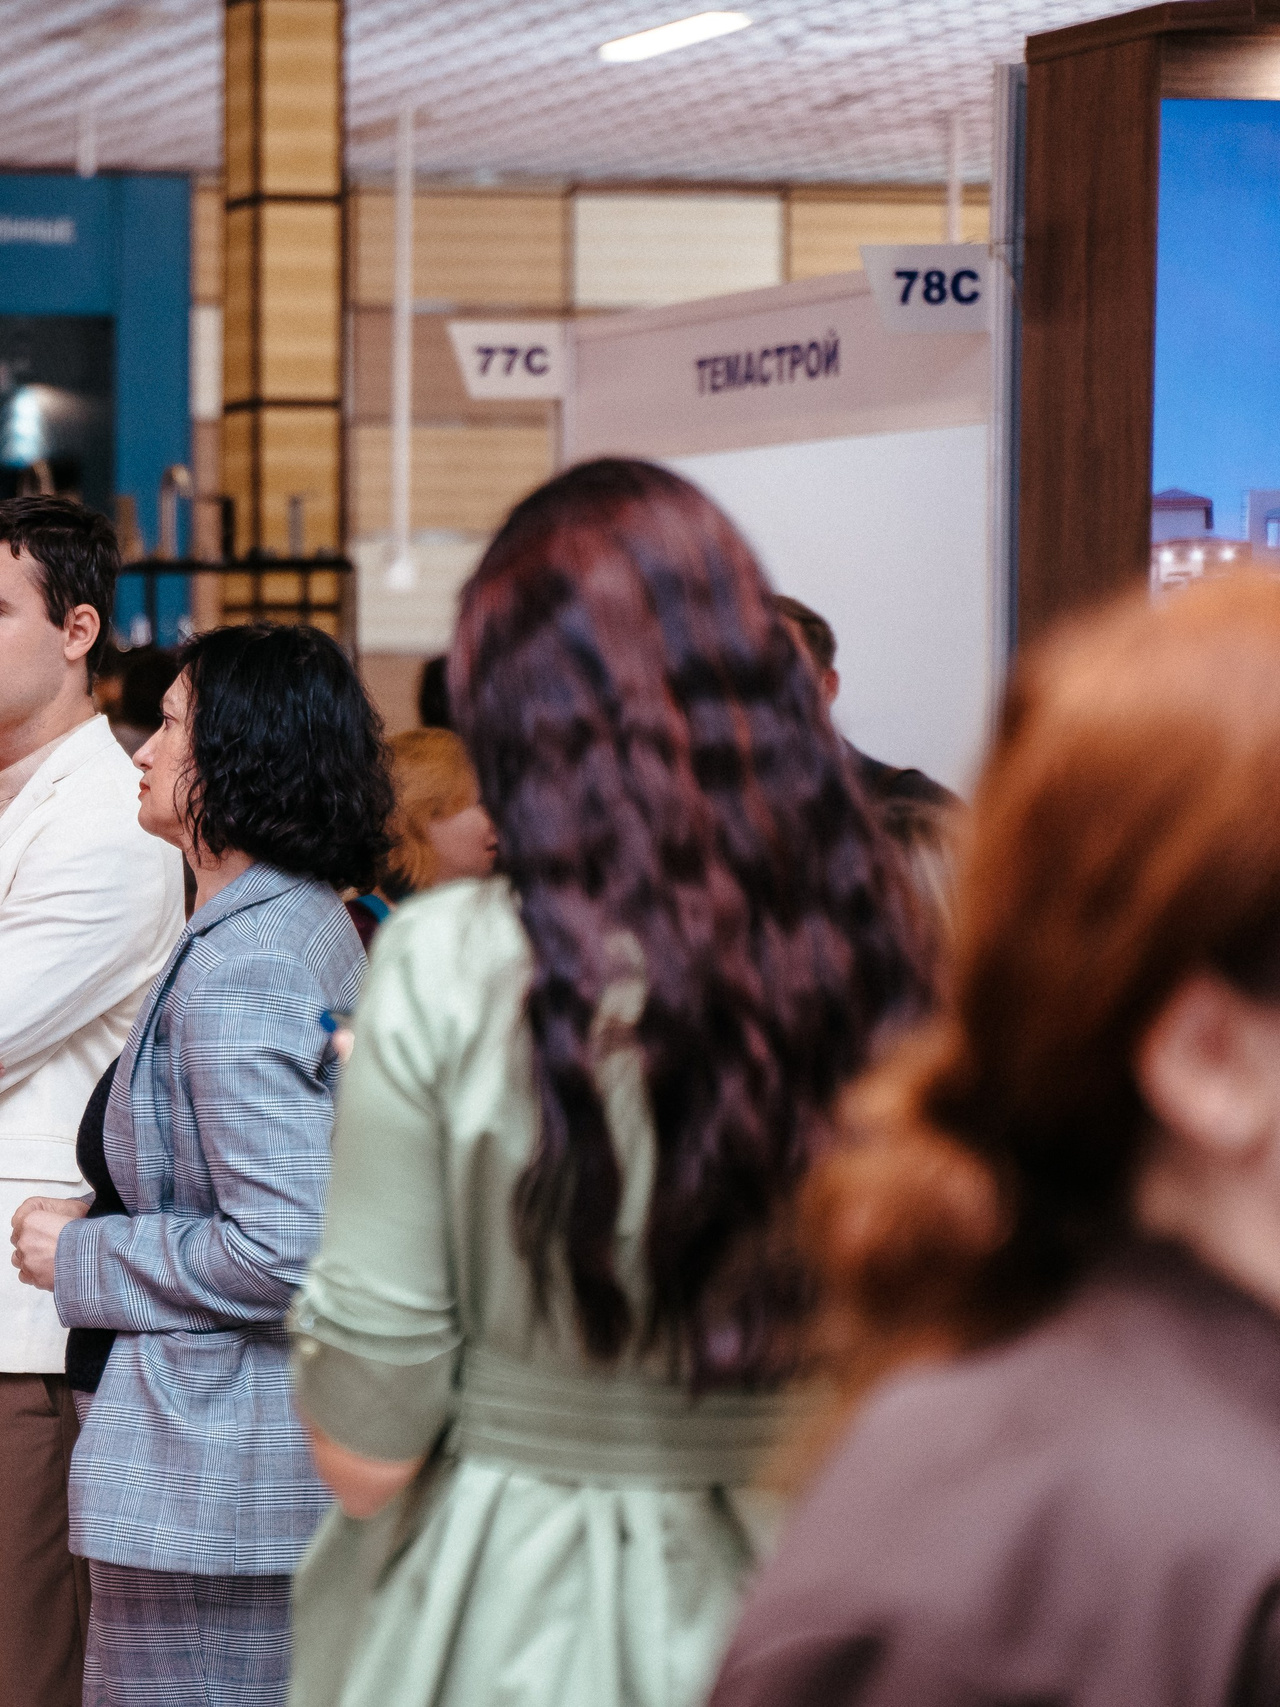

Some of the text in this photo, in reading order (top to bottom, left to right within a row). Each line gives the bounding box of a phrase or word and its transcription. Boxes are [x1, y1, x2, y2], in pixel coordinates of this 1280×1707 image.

[894, 269, 980, 305] 78C
[475, 345, 549, 377] 77C
[695, 329, 841, 395] ТЕМАСТРОЙ
